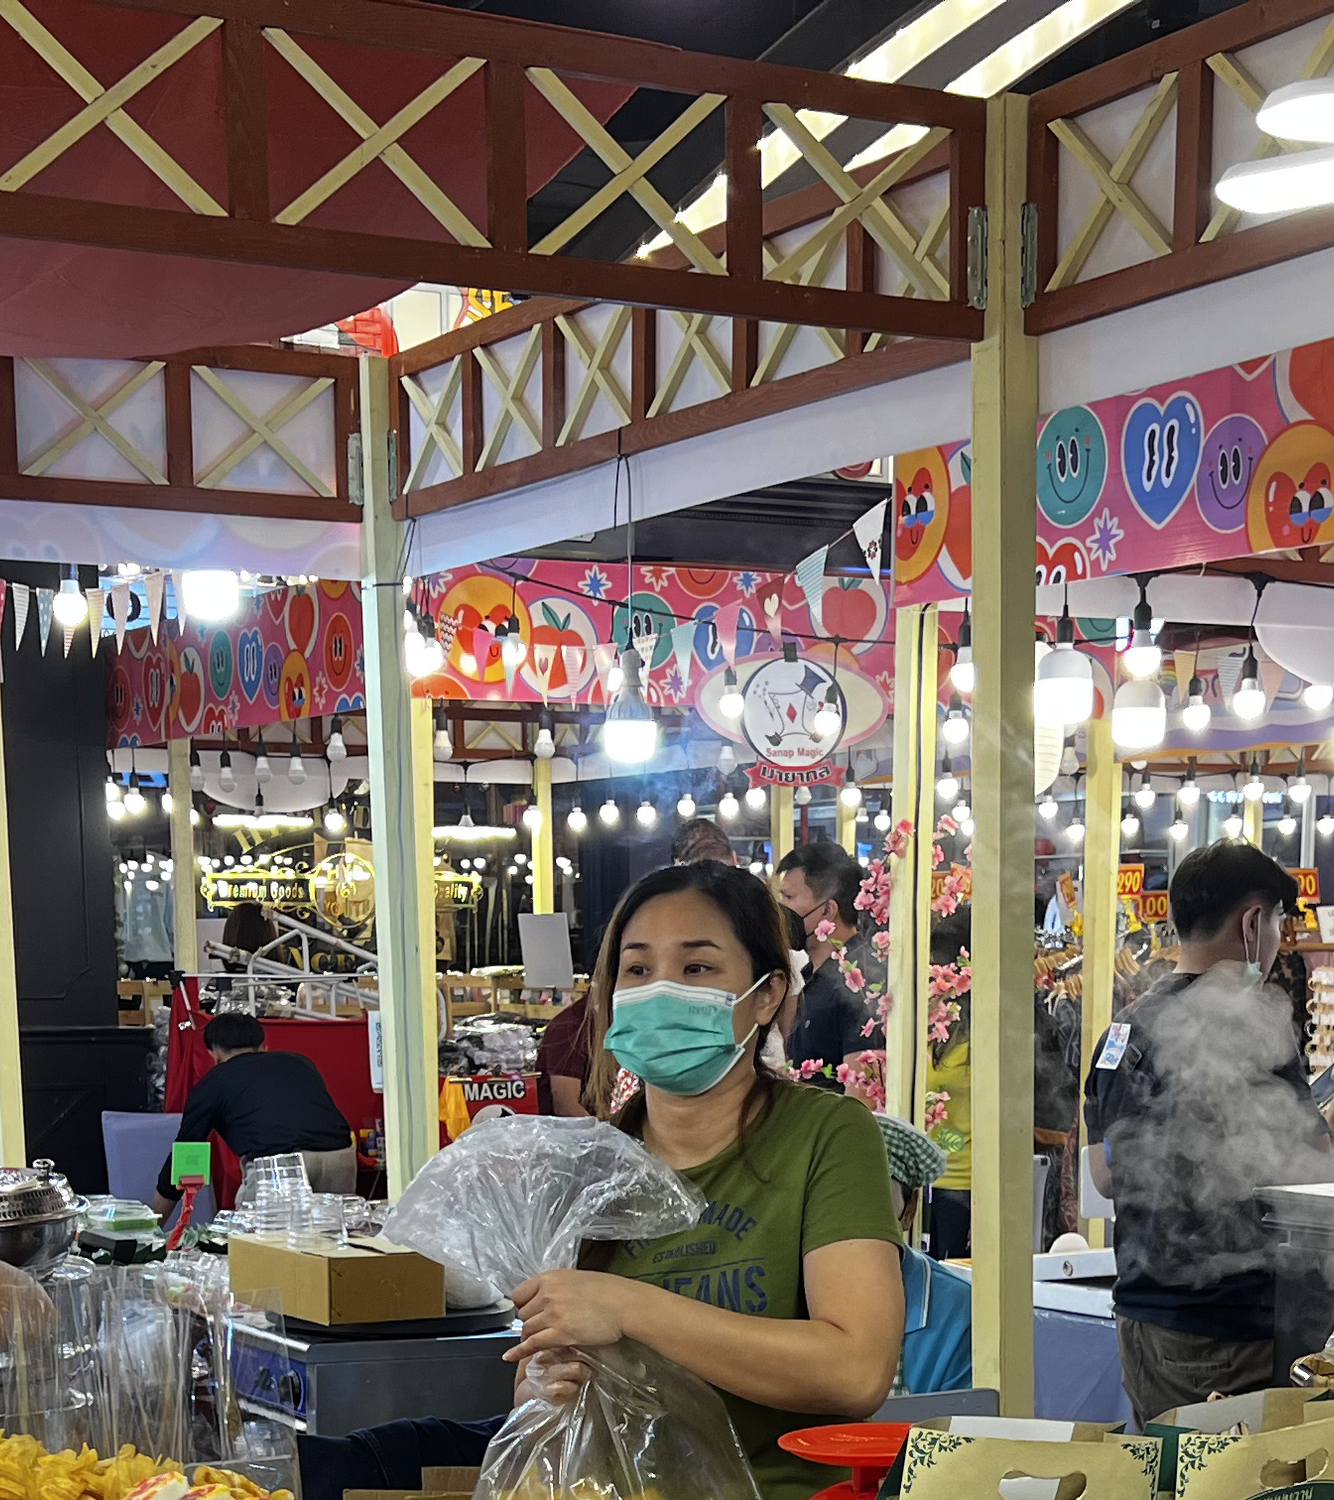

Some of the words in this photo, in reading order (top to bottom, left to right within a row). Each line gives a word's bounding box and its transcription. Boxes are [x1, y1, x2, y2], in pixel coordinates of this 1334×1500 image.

[766, 748, 794, 758] Sanap
[798, 748, 824, 758] Magic
[762, 766, 830, 783] มายากล
[270, 881, 305, 899] Goods
[1117, 871, 1140, 893] 290
[464, 1080, 526, 1101] MAGIC
[662, 1265, 768, 1313] ANS
